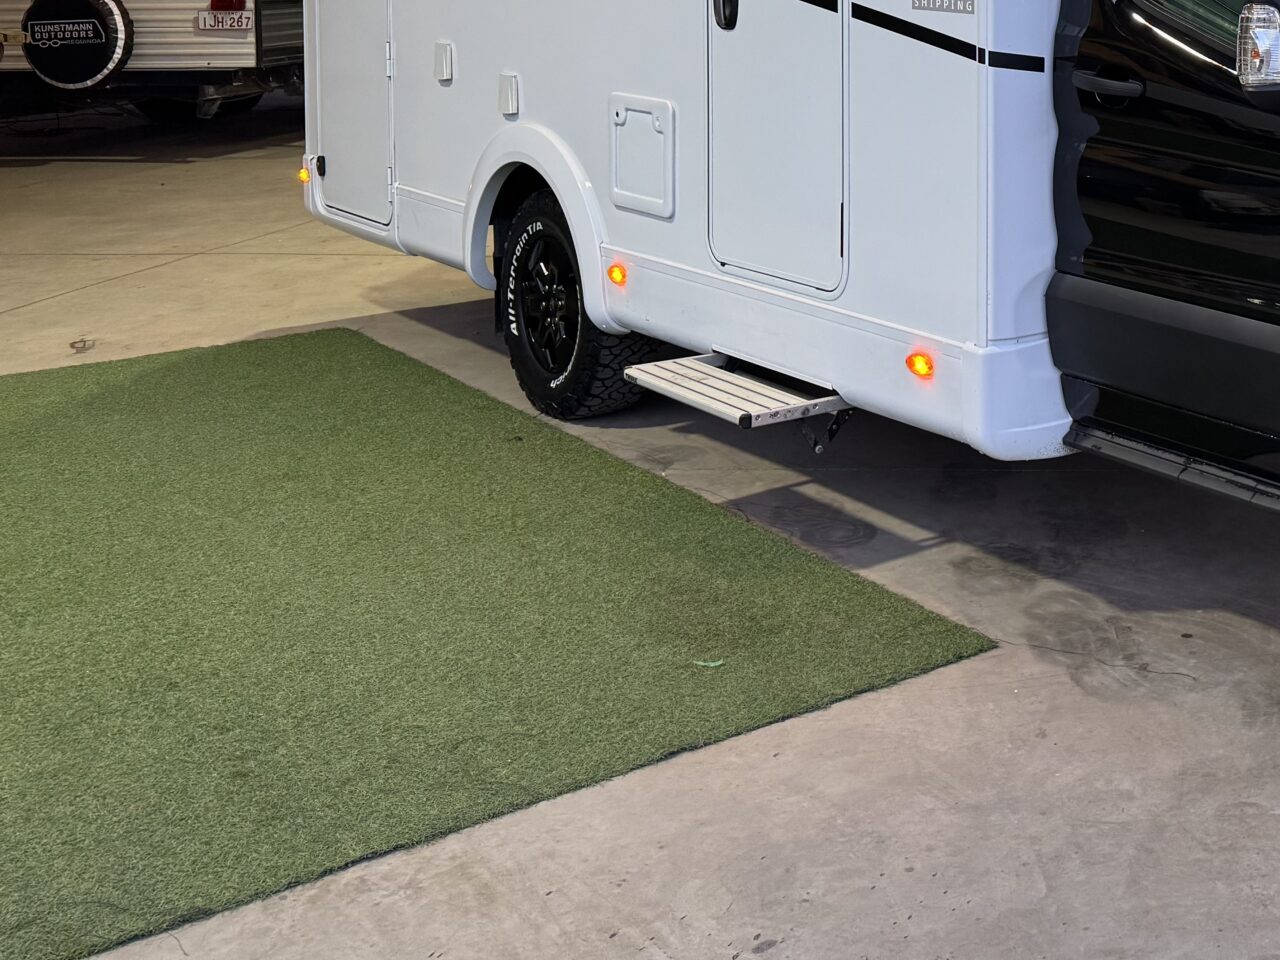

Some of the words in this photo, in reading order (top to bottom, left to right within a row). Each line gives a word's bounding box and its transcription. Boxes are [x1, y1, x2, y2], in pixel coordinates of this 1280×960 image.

[229, 16, 251, 28] 267
[34, 23, 93, 32] KUNSTMANN
[34, 31, 94, 39] OUTDOORS
